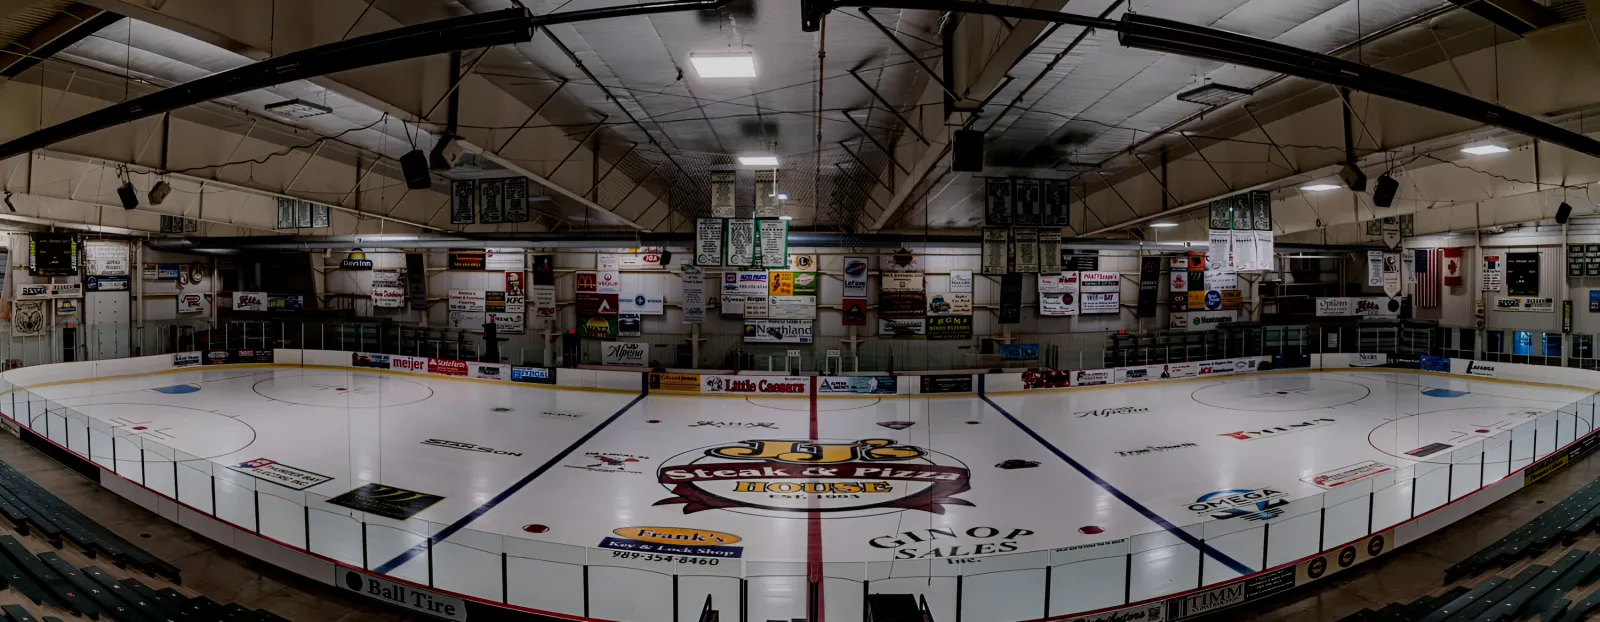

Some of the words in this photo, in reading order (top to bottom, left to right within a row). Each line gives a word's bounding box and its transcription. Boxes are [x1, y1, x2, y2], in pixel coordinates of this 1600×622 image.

[645, 254, 659, 263] IGA
[608, 344, 643, 361] Alpena
[393, 357, 424, 371] meijer
[725, 379, 757, 393] Little
[759, 380, 806, 393] Caesars
[664, 466, 788, 480] Steak
[801, 465, 840, 476] &
[854, 466, 963, 481] Pizza
[734, 481, 893, 493] HOUSE
[1188, 489, 1281, 511] OMEGA
[637, 529, 725, 543] Frank's
[868, 526, 1034, 549] GINOP
[608, 541, 635, 549] Key
[656, 546, 693, 554] Lock
[697, 548, 734, 557] Shop
[895, 541, 1018, 560] SALES
[612, 550, 719, 566] 989-354-8460
[367, 578, 405, 604] Ball
[410, 591, 455, 616] Tire
[1187, 584, 1242, 607] TIMM
